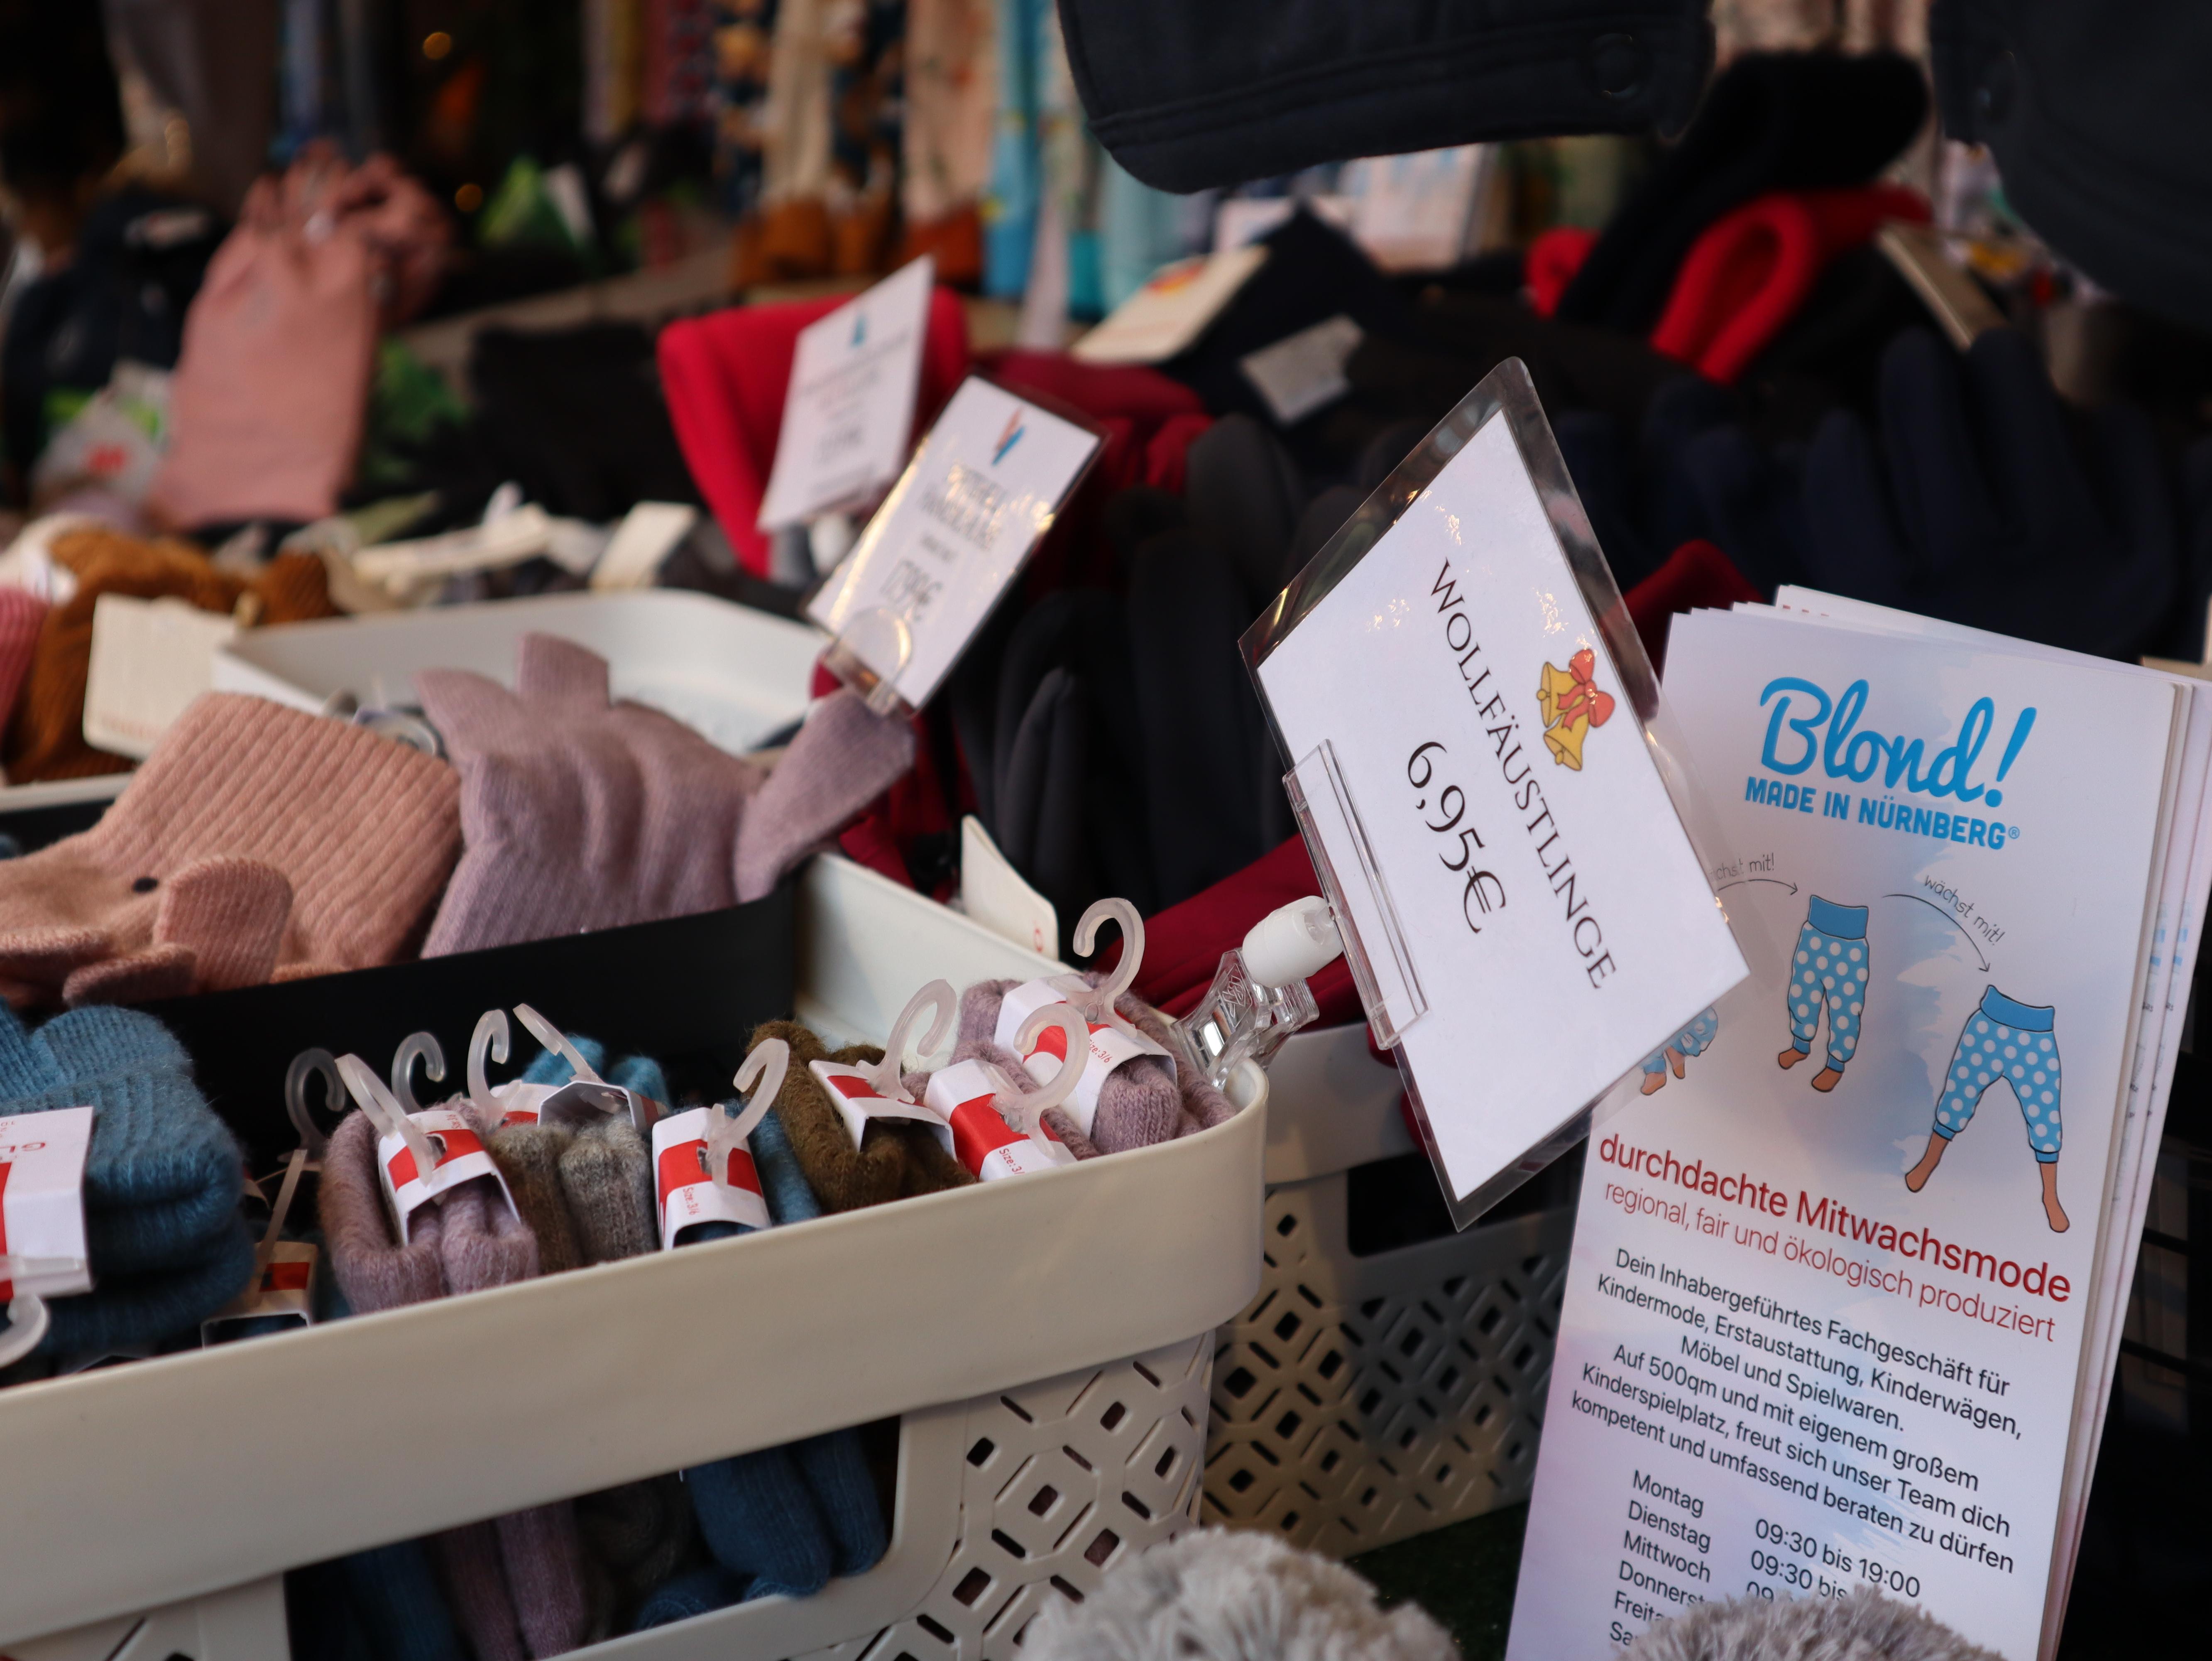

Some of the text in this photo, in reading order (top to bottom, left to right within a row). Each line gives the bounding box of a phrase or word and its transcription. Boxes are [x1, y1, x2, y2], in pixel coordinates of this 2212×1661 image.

[1430, 558, 1616, 989] WOLLFÄUSTLINGE
[1745, 777, 1817, 813] MADE
[1823, 791, 1851, 821] IN
[1760, 676, 2037, 807] Blond!
[1407, 741, 1506, 934] 6,95€
[1749, 853, 1774, 872] mit!
[1924, 875, 2006, 946] wächst mit!
[1089, 1039, 1113, 1063] ize: 3/6
[999, 1148, 1025, 1175] Size: 3/
[1600, 1133, 2071, 1302] durchdachte Mitwachsmode
[1606, 1183, 2055, 1342] regional, fair und ökologisch produziert
[1616, 1248, 2010, 1396] Dein Inhabergeführtes Fachgeschäft für
[1598, 1273, 2021, 1440] Kindermode, Erstaustattung, Kinderwägen,
[1613, 1344, 1979, 1492] Auf 500qm und mit eigenem großem
[1681, 1335, 1904, 1431] Möbel und Spielwaren.
[1572, 1390, 2013, 1574] kompetent und umfassend beraten zu dürfen
[1583, 1362, 2010, 1537] Kinderspielplatz, freut sich unser Team dich
[1623, 1530, 1711, 1583] Mittwoch
[1628, 1499, 1711, 1554] Dienstag
[1751, 1550, 1813, 1590] 09:30
[1632, 1470, 1921, 1598] Montag 09:30 bis 19:00
